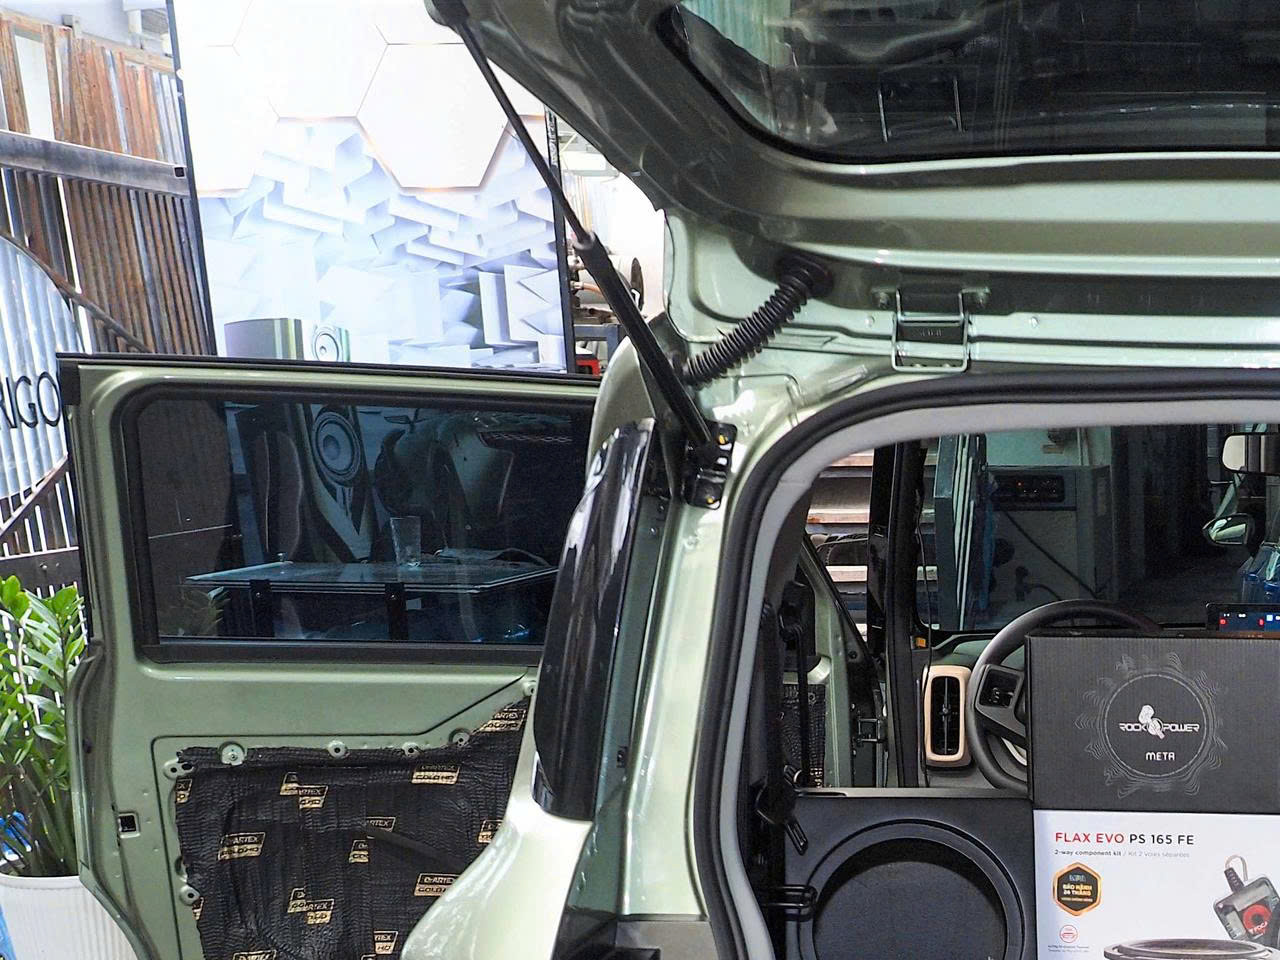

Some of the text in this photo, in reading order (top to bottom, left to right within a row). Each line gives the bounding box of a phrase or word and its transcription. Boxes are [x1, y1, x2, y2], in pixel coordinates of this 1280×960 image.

[1119, 723, 1200, 732] ROCK POWER
[1145, 751, 1176, 761] META
[1055, 832, 1195, 845] FLAX EVO PS 165 FE
[1075, 850, 1112, 858] component
